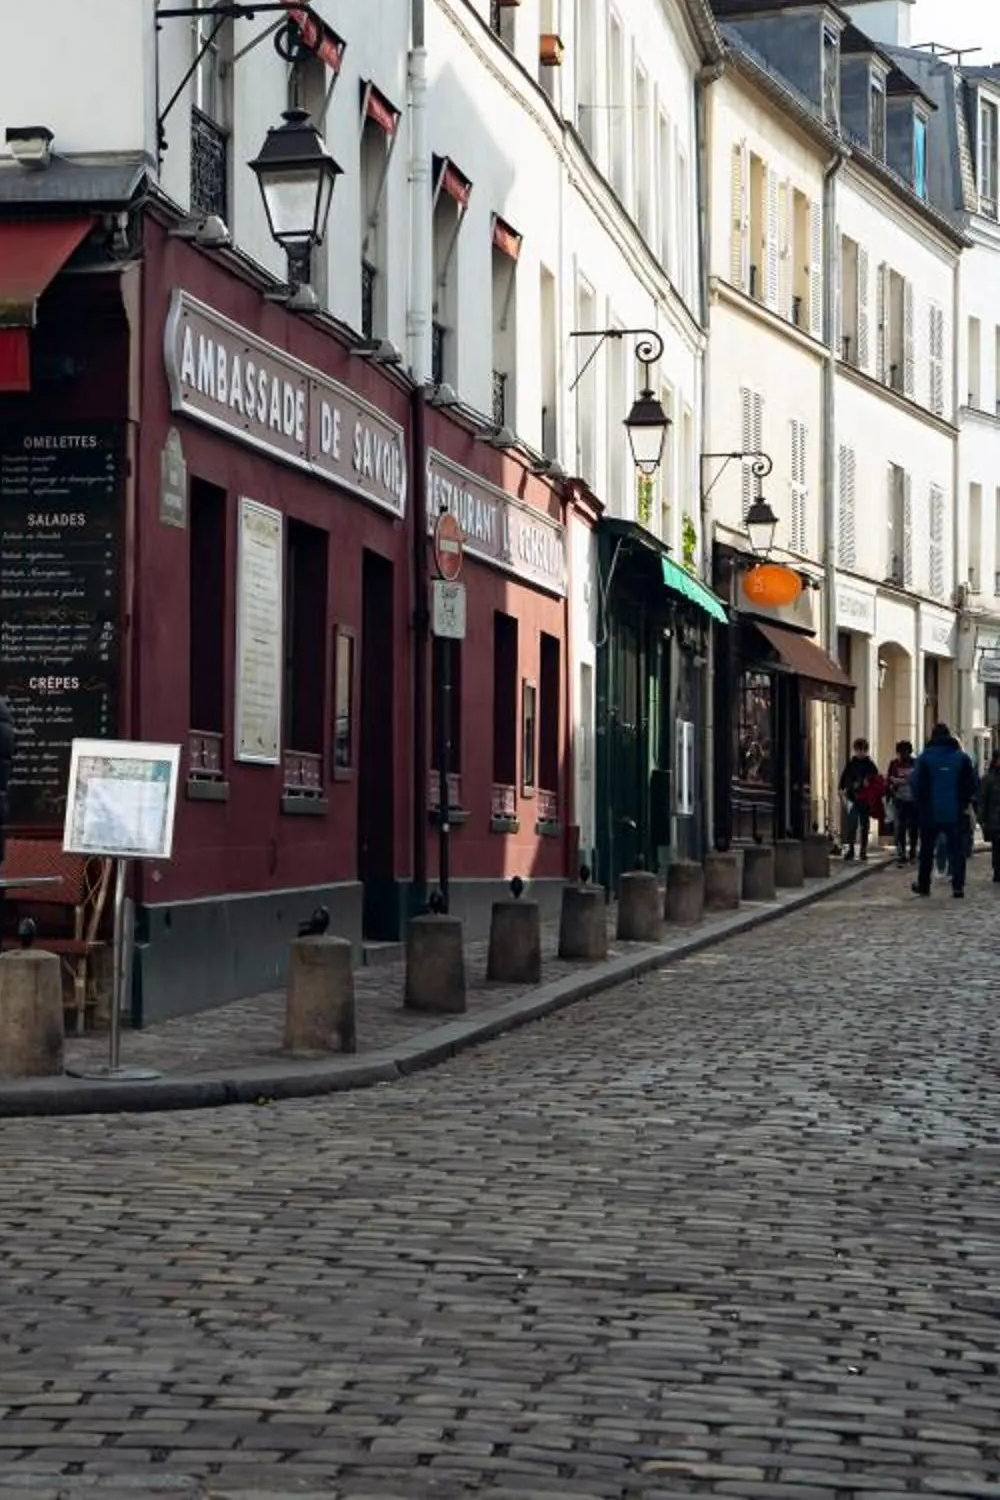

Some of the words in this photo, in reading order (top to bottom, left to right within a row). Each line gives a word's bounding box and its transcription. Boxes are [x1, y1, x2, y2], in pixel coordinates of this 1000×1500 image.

[180, 325, 306, 444] AMBASSADE
[320, 400, 341, 460] DE
[23, 435, 97, 449] OMELETTES
[27, 513, 86, 527] SALADES
[29, 675, 80, 690] CRÊPES
